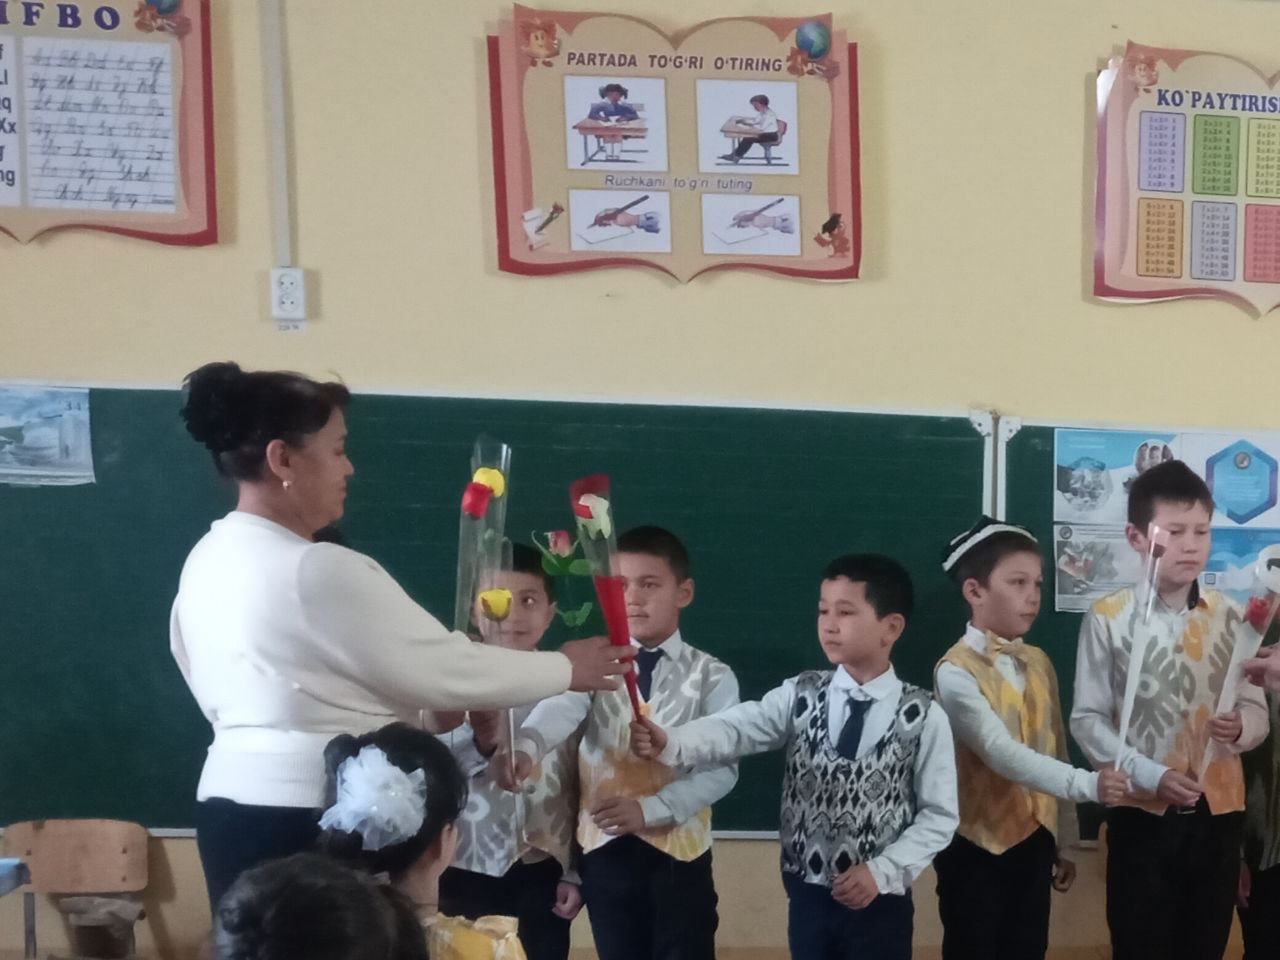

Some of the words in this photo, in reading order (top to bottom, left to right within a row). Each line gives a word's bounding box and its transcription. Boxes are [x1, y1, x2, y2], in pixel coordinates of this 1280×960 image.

[567, 52, 638, 67] PARTADA
[604, 174, 666, 188] Ruchkani
[717, 178, 754, 193] tuting
